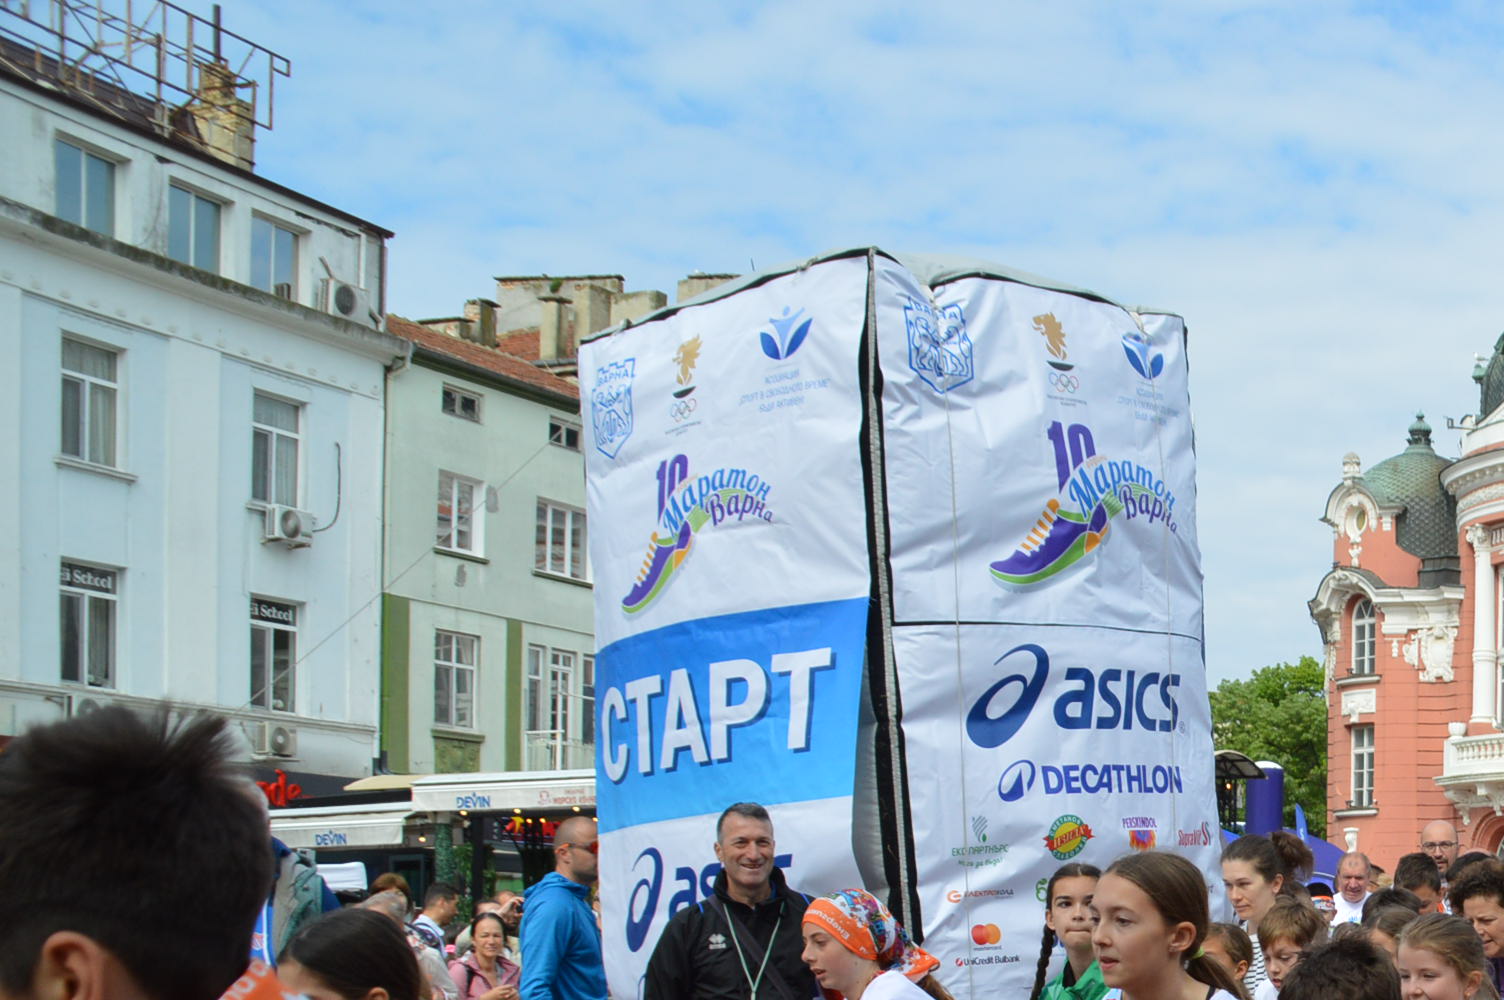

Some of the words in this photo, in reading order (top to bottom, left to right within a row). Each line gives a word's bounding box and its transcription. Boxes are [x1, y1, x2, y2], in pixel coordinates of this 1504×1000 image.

[1047, 421, 1096, 494] 10
[656, 454, 688, 524] 10
[663, 468, 771, 540] Маратон
[705, 493, 773, 526] Варна
[1069, 460, 1175, 519] Маратон
[1119, 484, 1177, 533] Варна
[72, 568, 112, 590] School
[260, 602, 293, 622] School
[601, 647, 834, 783] СТАРТ
[1053, 667, 1181, 733] asics
[1041, 764, 1183, 795] DECATHLON
[456, 793, 491, 810] DEVIN
[1122, 816, 1157, 828] PERSKINDOL
[315, 831, 347, 846] DEVIN
